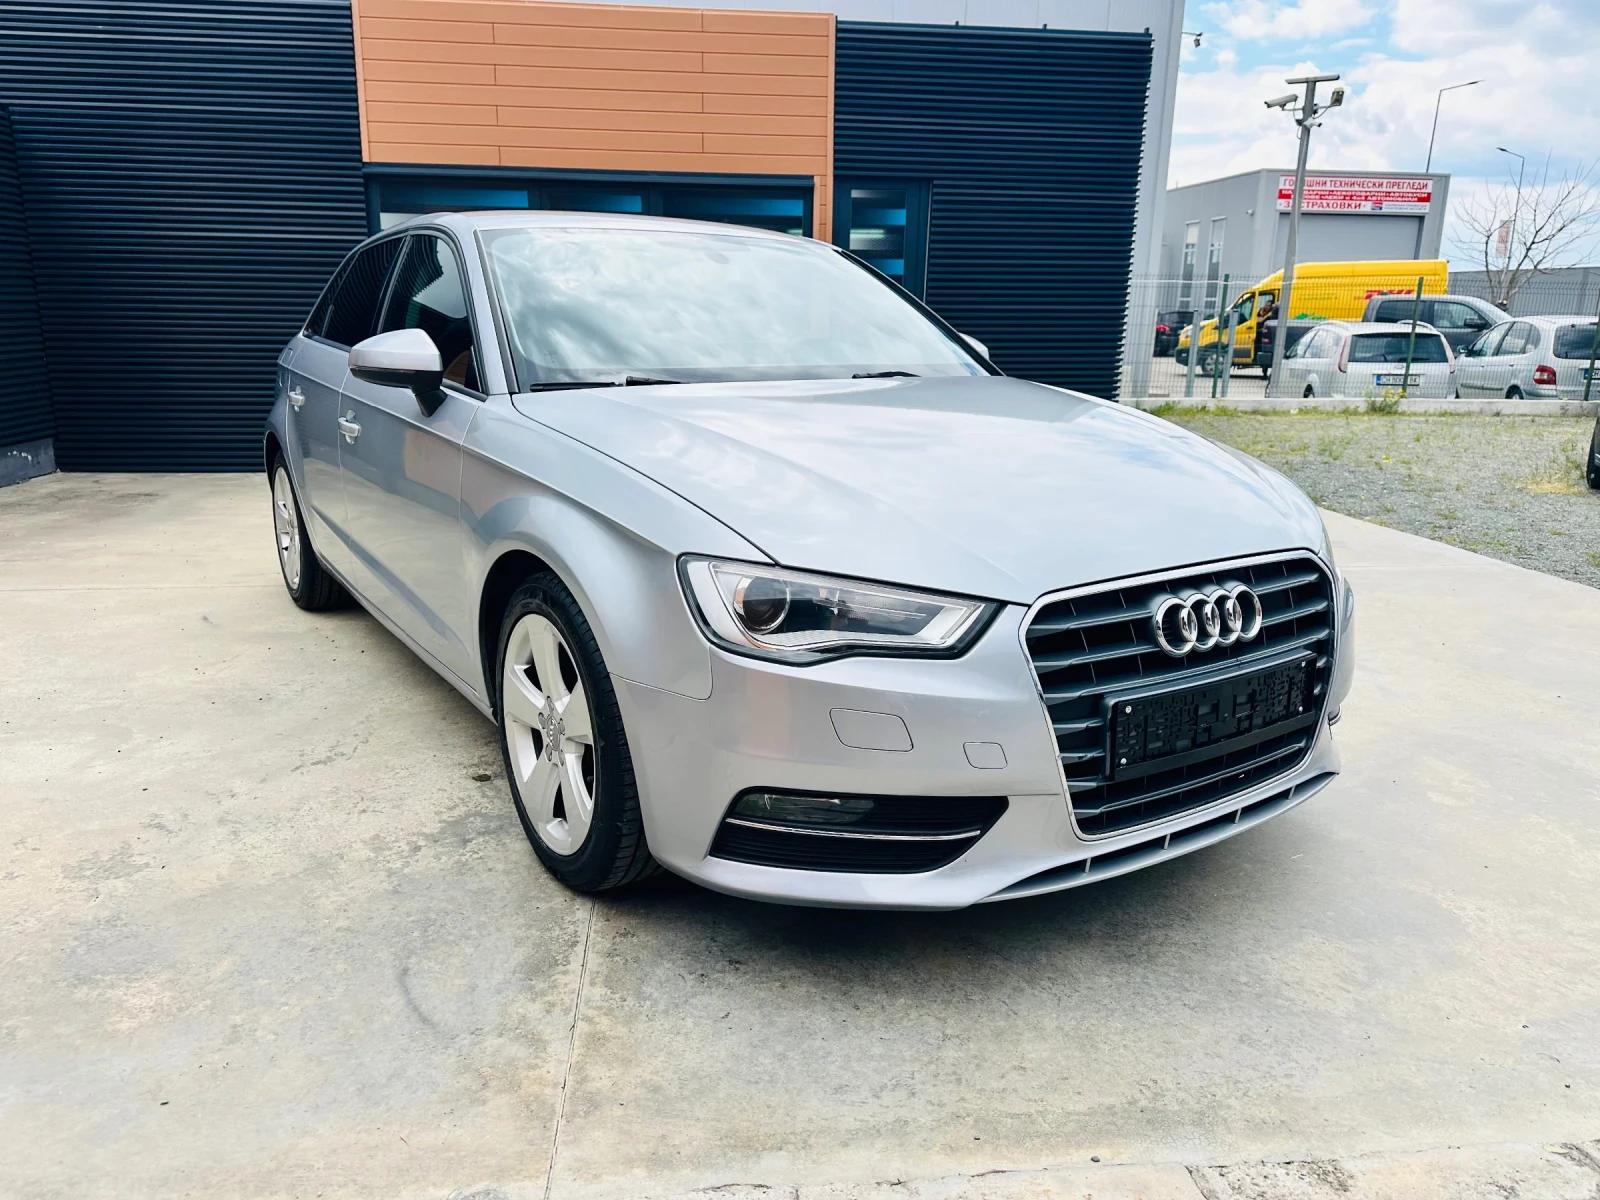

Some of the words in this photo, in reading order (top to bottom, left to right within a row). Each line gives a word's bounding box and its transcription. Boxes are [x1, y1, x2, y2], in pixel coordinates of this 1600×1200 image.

[1284, 178, 1327, 188] ГОШНИ
[1330, 180, 1383, 188] ТЕХНИЧЕСКИ
[1386, 181, 1428, 190] ПРЕГЛЕДИ
[1284, 201, 1361, 209] ЗСТРАХОВКИ
